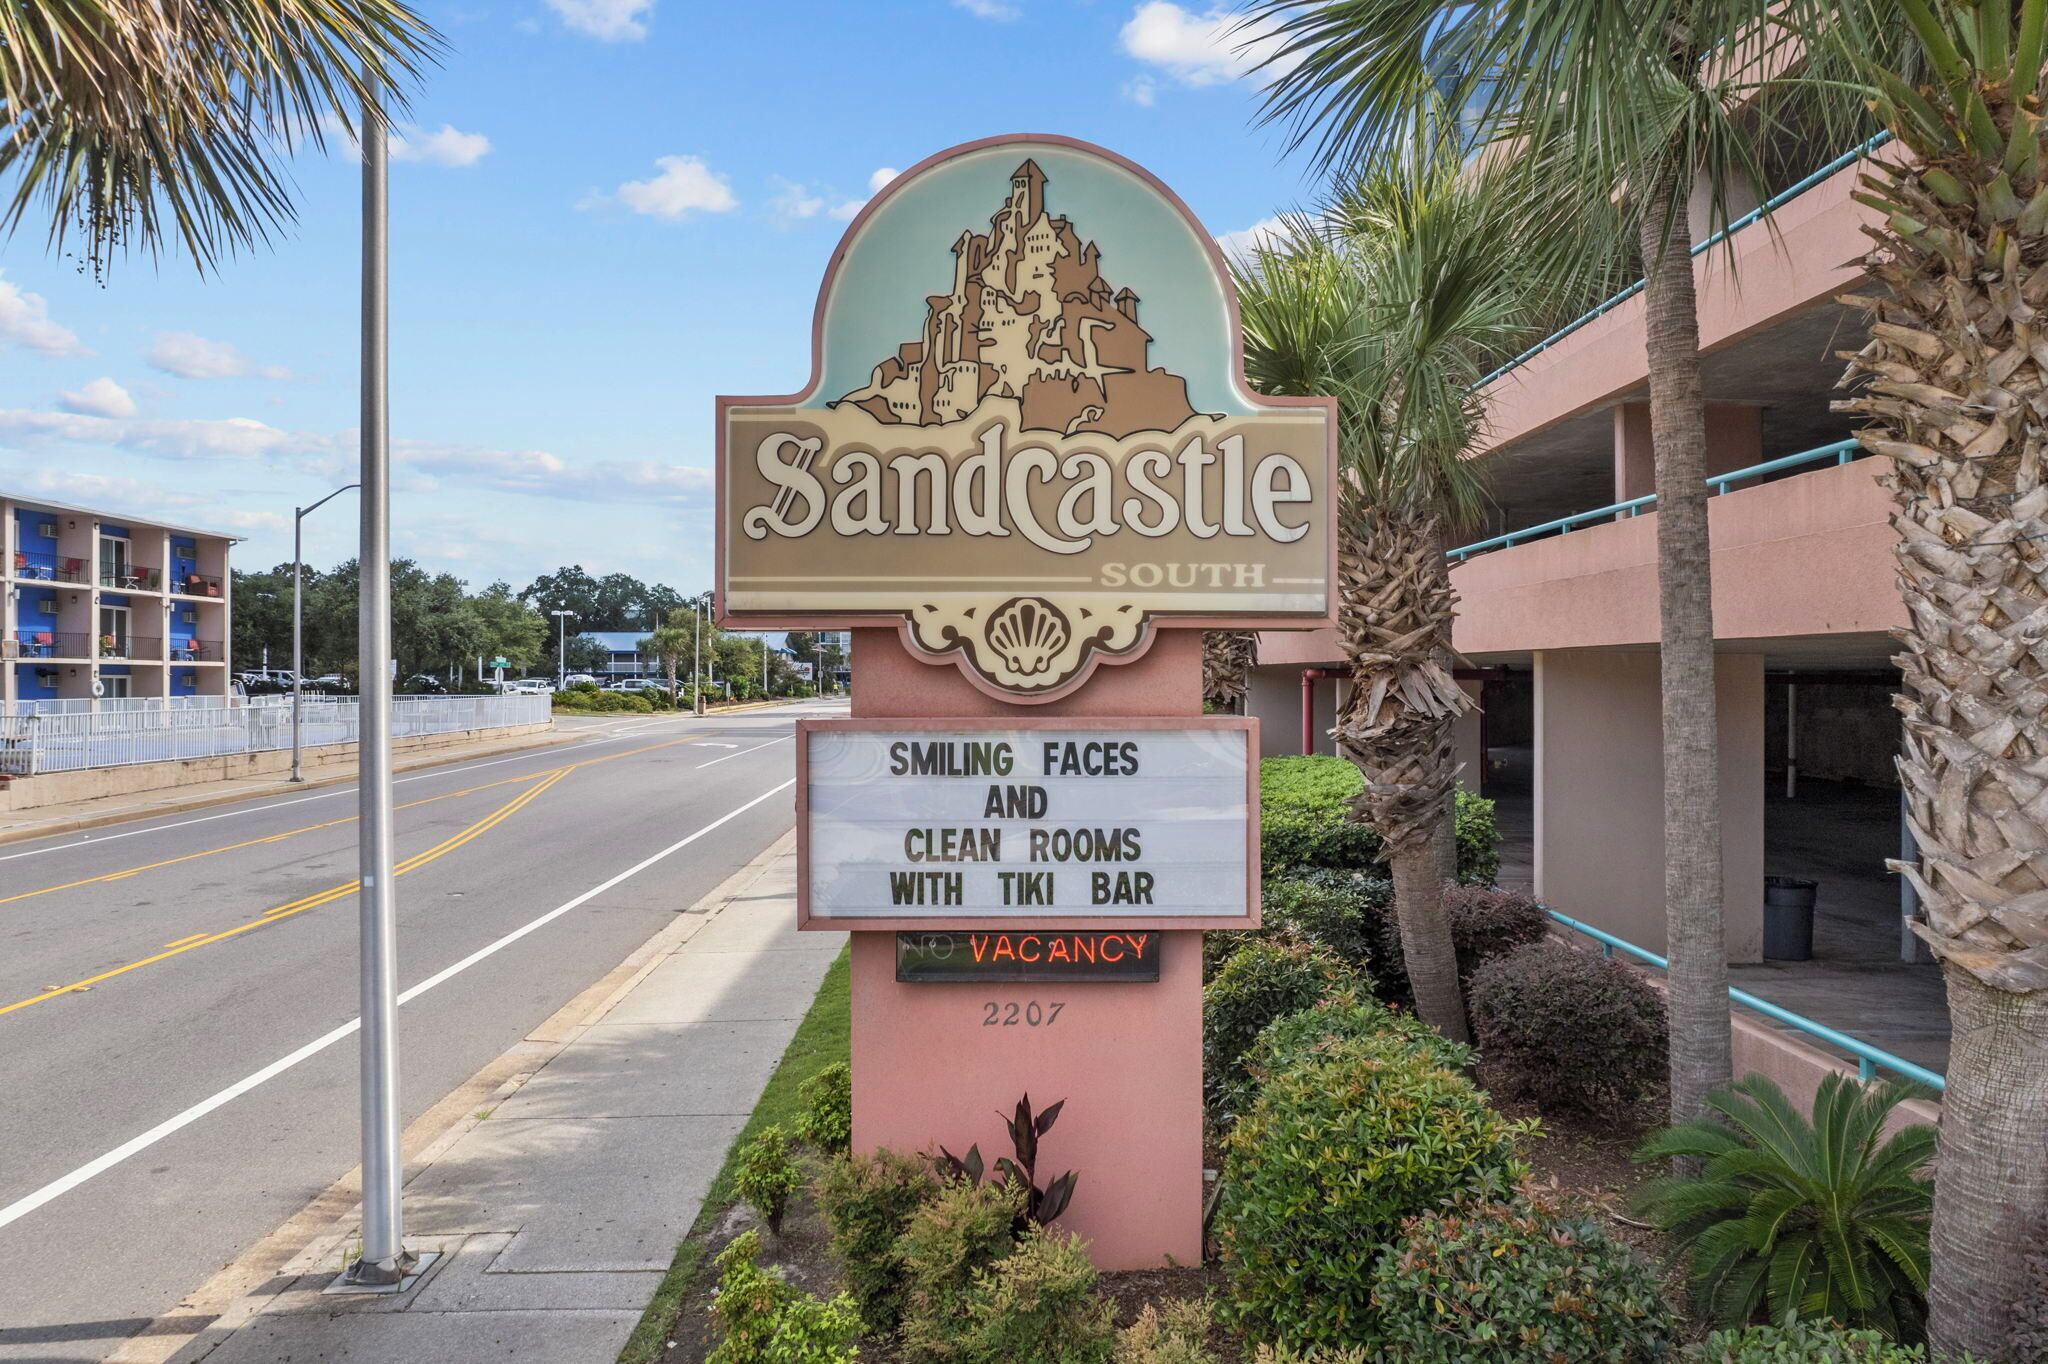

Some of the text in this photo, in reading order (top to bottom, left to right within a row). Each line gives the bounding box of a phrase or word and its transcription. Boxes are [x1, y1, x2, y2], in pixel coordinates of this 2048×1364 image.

[1101, 562, 1266, 588] SOUTH
[890, 741, 1139, 776] SMILING FACES
[984, 785, 1048, 819] AND
[904, 828, 1141, 862] CLEAN ROOMS
[890, 872, 1155, 906] WITH TIKI BAR
[903, 934, 1147, 963] NO VACANCY
[983, 1000, 1066, 1027] 2207
